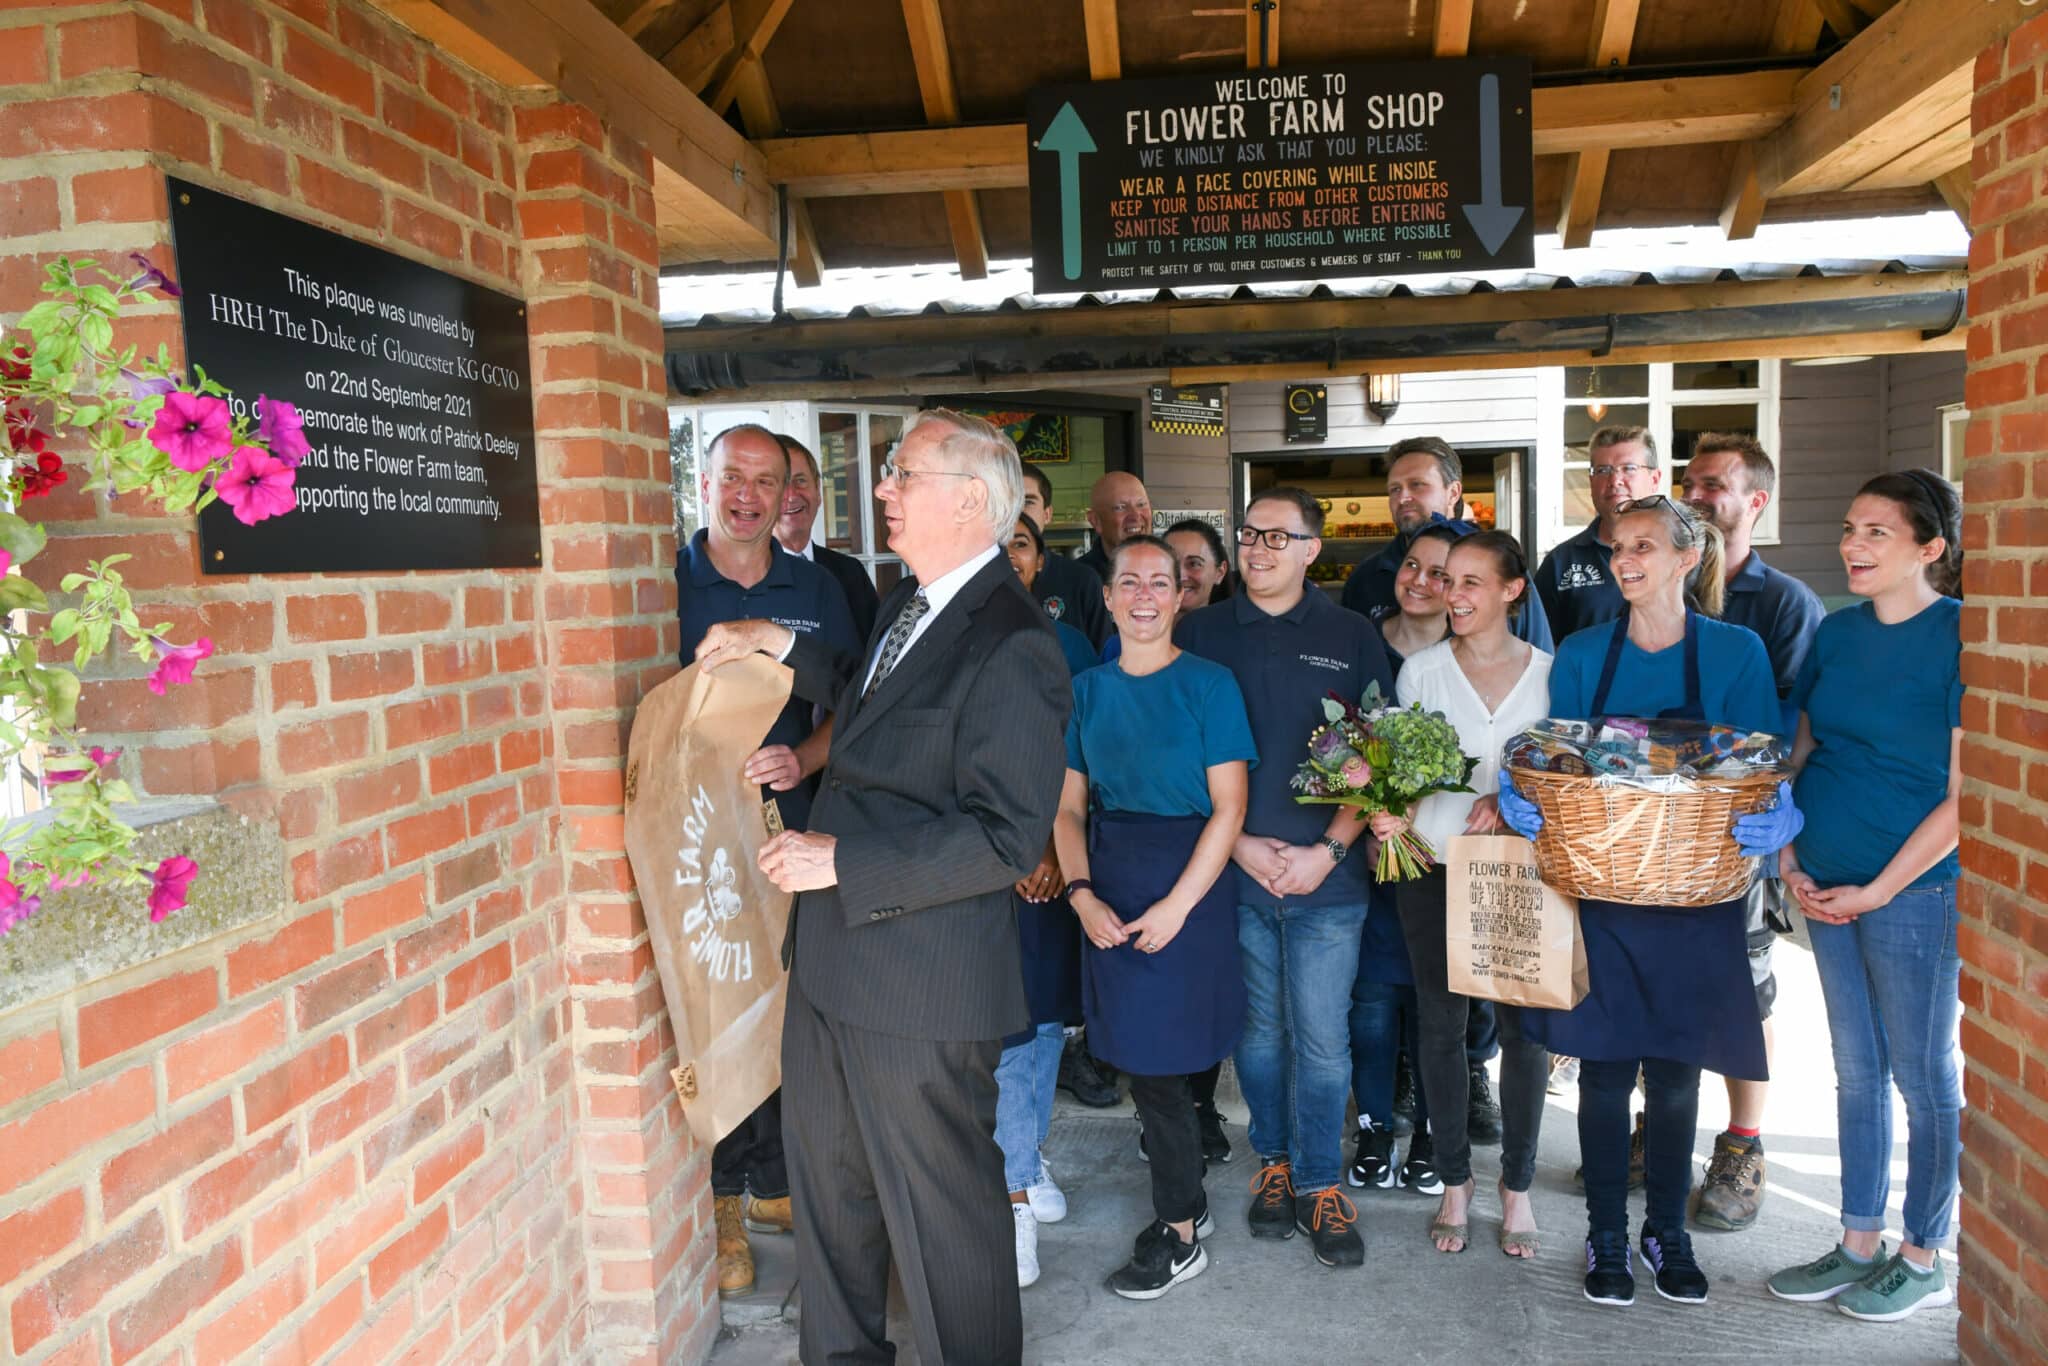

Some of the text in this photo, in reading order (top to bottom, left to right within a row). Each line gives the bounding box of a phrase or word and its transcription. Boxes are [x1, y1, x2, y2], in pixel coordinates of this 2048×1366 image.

[1215, 73, 1346, 103] WELCOME TO
[1126, 91, 1444, 145] FLOWER FARM SHOP
[1139, 132, 1428, 169] WE KINDLY ASK THAT YOU PLEASE:
[1120, 160, 1437, 197] WEAR A FACE COVERING WHILE INSIDE
[1110, 181, 1449, 217] KEEP YOUR DISTANCE FROM OTHER CUSTOMERS
[1115, 202, 1445, 238] SANITISE YOUR HANDS BEFORE ENTERING
[1107, 223, 1451, 257] LIMIT TO 1 PERSON PER HOUSEHOLD WHERE POSSIBLE
[1102, 266, 1134, 278] PROTECT
[1140, 265, 1155, 276] THE
[1159, 263, 1189, 275] SAFETY
[1193, 263, 1203, 273] OF
[1231, 260, 1255, 271] OTHER
[1260, 257, 1305, 270] CUSTOMERS
[1321, 254, 1358, 266] MEMBERS
[1363, 253, 1373, 264] OF
[1378, 252, 1401, 263] STAFF
[1418, 249, 1443, 260] THANK
[1445, 249, 1462, 259] YOU
[283, 267, 475, 348] This plaque was unveiled by
[209, 293, 520, 390] HRH The Duke of Gloucester KG GCVO
[305, 370, 472, 418] on 22nd September 2021
[227, 392, 246, 417] to
[372, 415, 394, 438] the
[397, 422, 428, 443] work
[430, 424, 442, 445] of
[445, 426, 483, 451] Patrick
[485, 433, 520, 460] Deeley
[333, 445, 360, 471] the
[364, 448, 414, 477] Flower
[417, 454, 451, 480] Farm
[454, 460, 488, 487] team,
[372, 486, 396, 511] the
[400, 488, 432, 512] local
[435, 494, 502, 521] community.
[675, 783, 753, 984] FLOWER FARM
[1469, 862, 1511, 878] FLOWER
